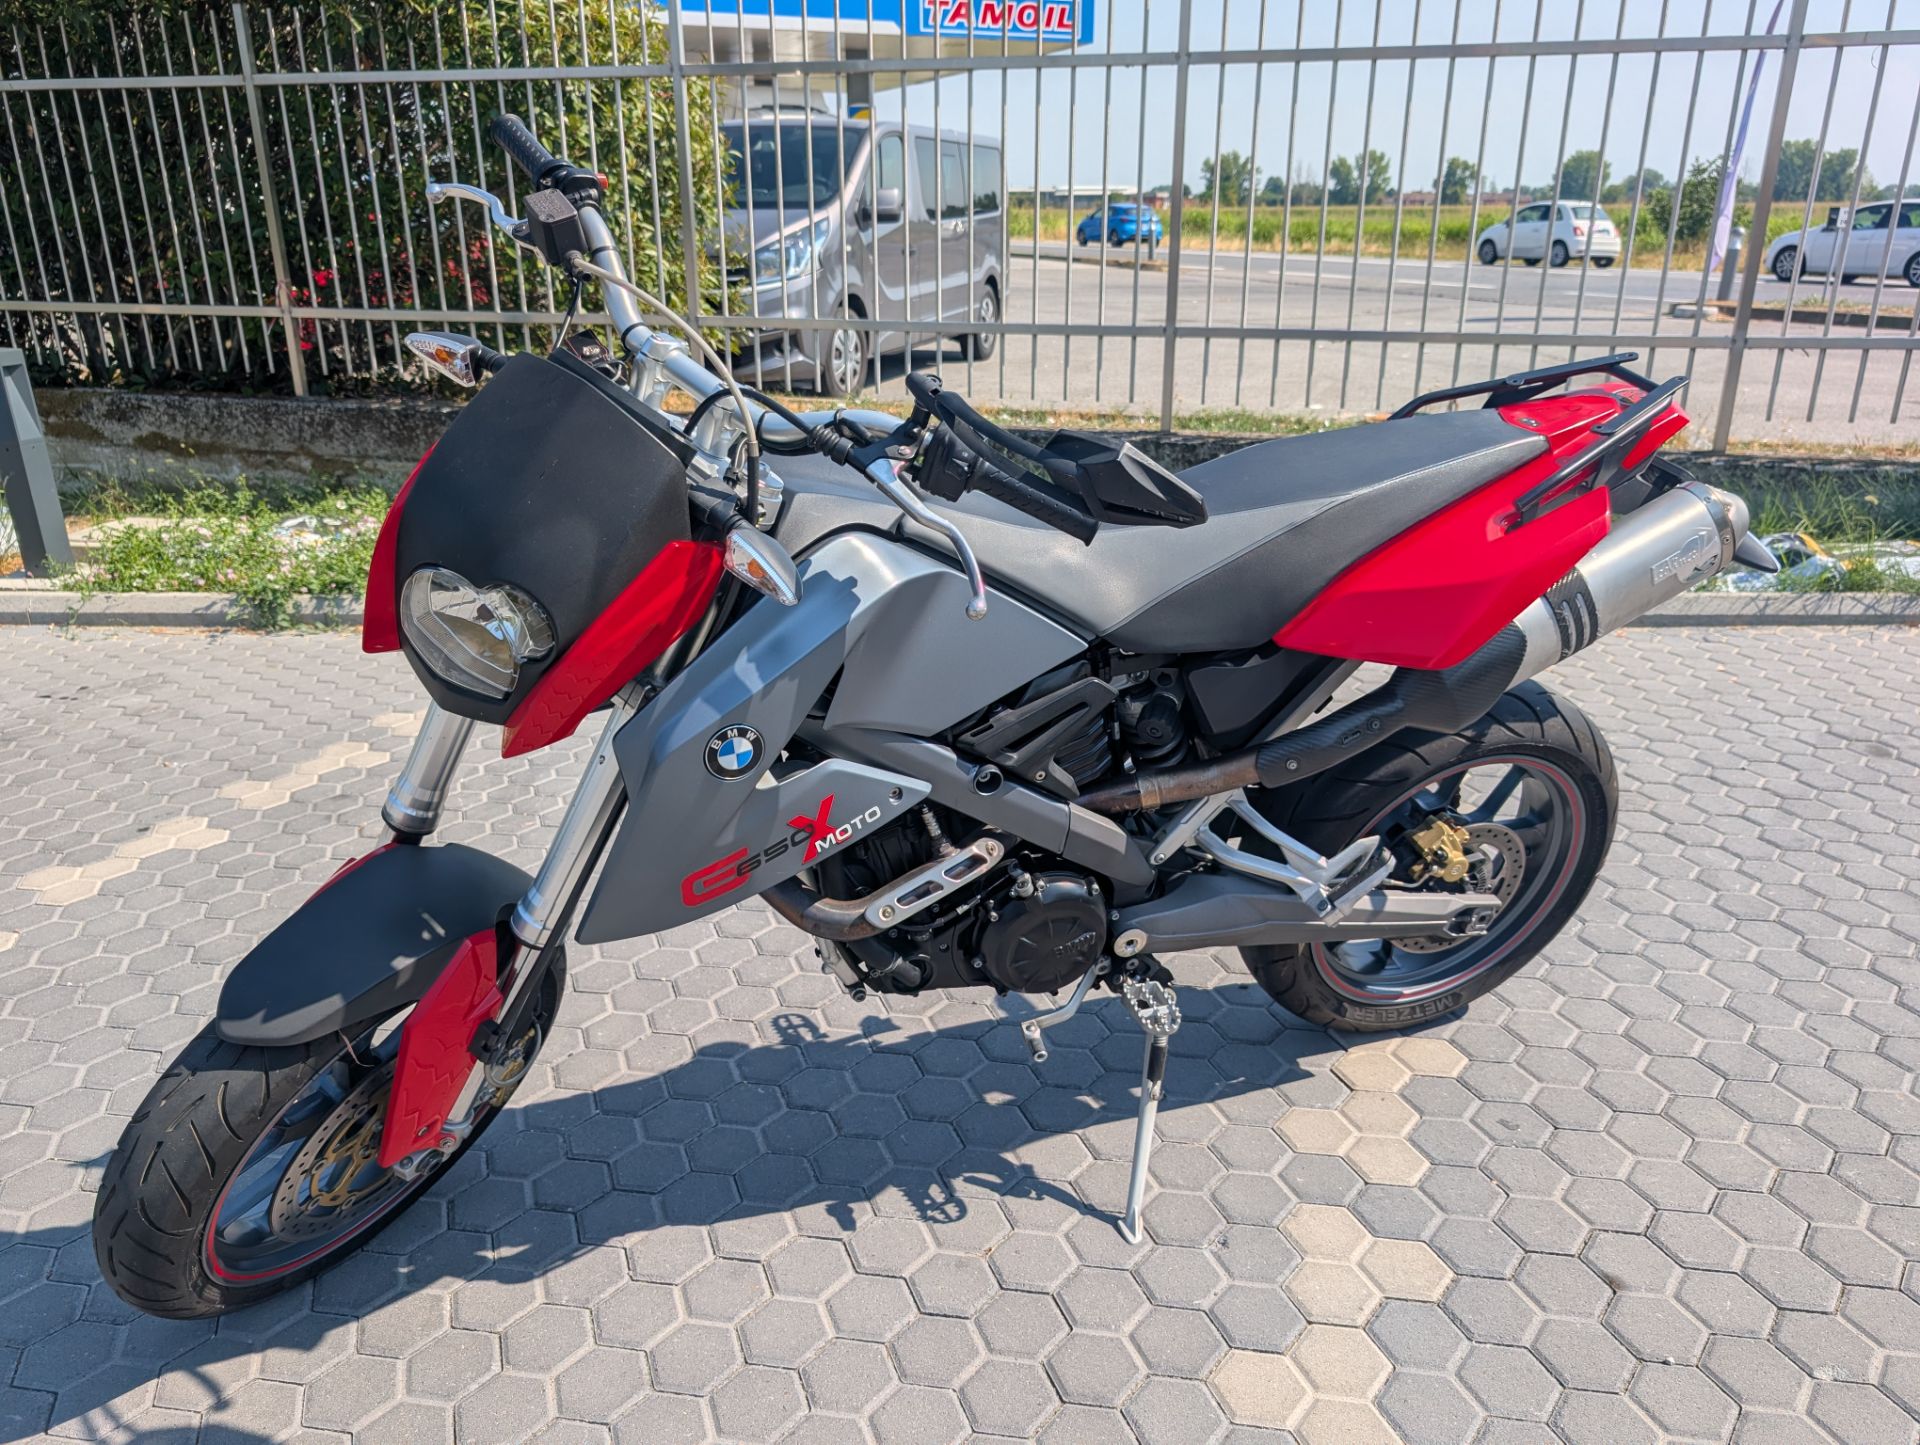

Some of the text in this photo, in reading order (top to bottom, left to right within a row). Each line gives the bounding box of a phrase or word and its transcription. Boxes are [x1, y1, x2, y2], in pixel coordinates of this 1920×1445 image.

[924, 0, 1073, 31] TAMOIL
[710, 728, 757, 750] BMW
[1353, 995, 1454, 1021] METZELER
